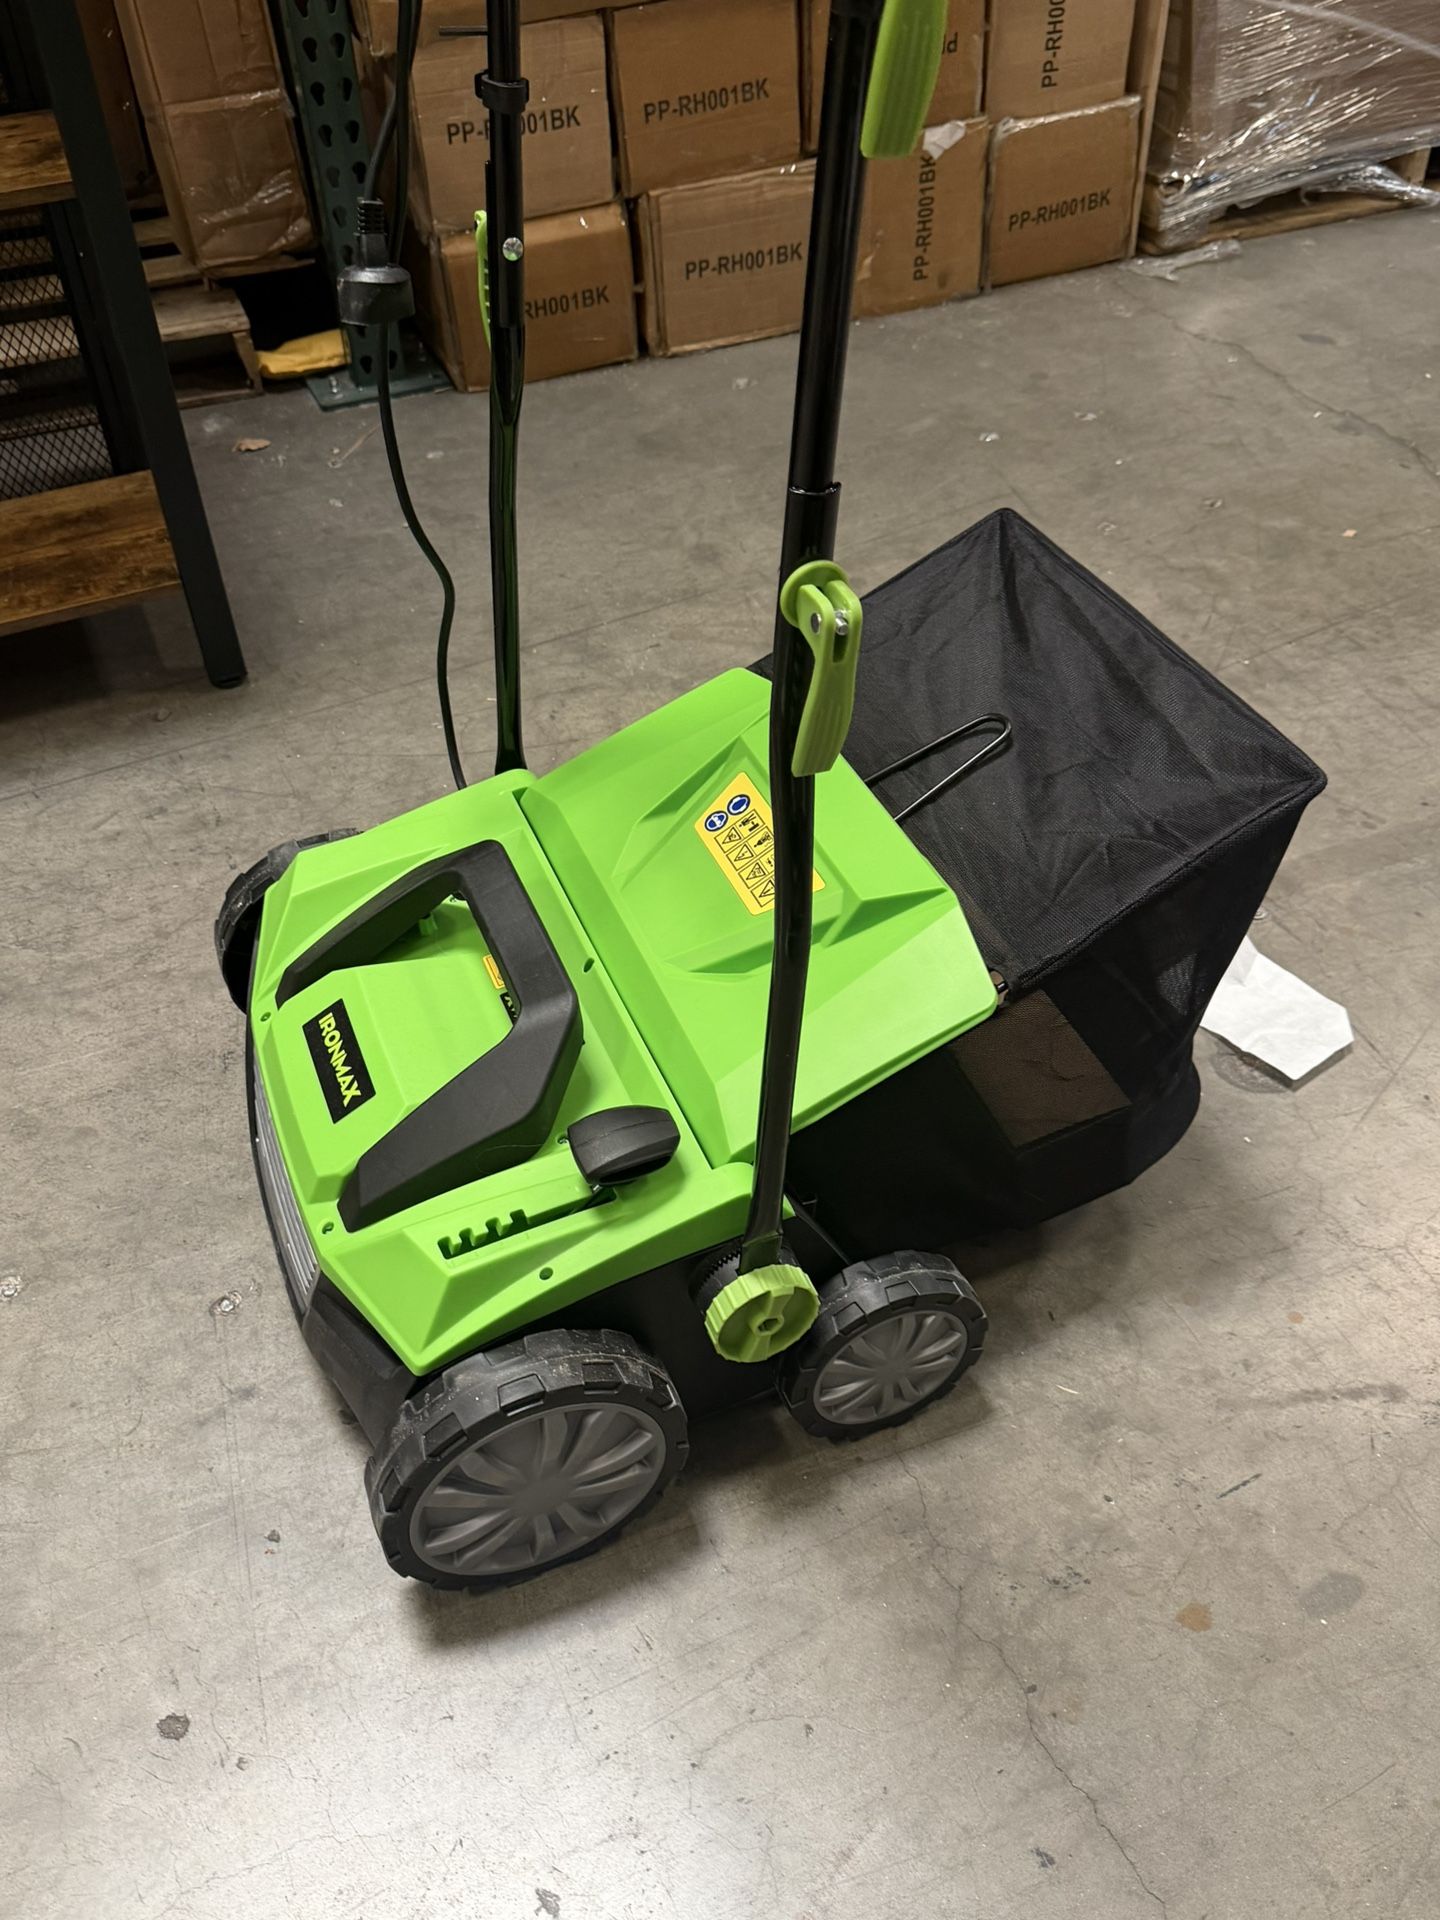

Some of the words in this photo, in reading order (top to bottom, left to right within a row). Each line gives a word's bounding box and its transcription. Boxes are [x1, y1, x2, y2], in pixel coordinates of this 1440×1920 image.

[643, 78, 769, 125] PP-RH001BK
[913, 154, 936, 281] PP-RH001BK
[1008, 188, 1111, 232] PP-RH001BK
[685, 242, 802, 280] PP-RH001BK
[318, 1011, 362, 1108] IRONMAX
